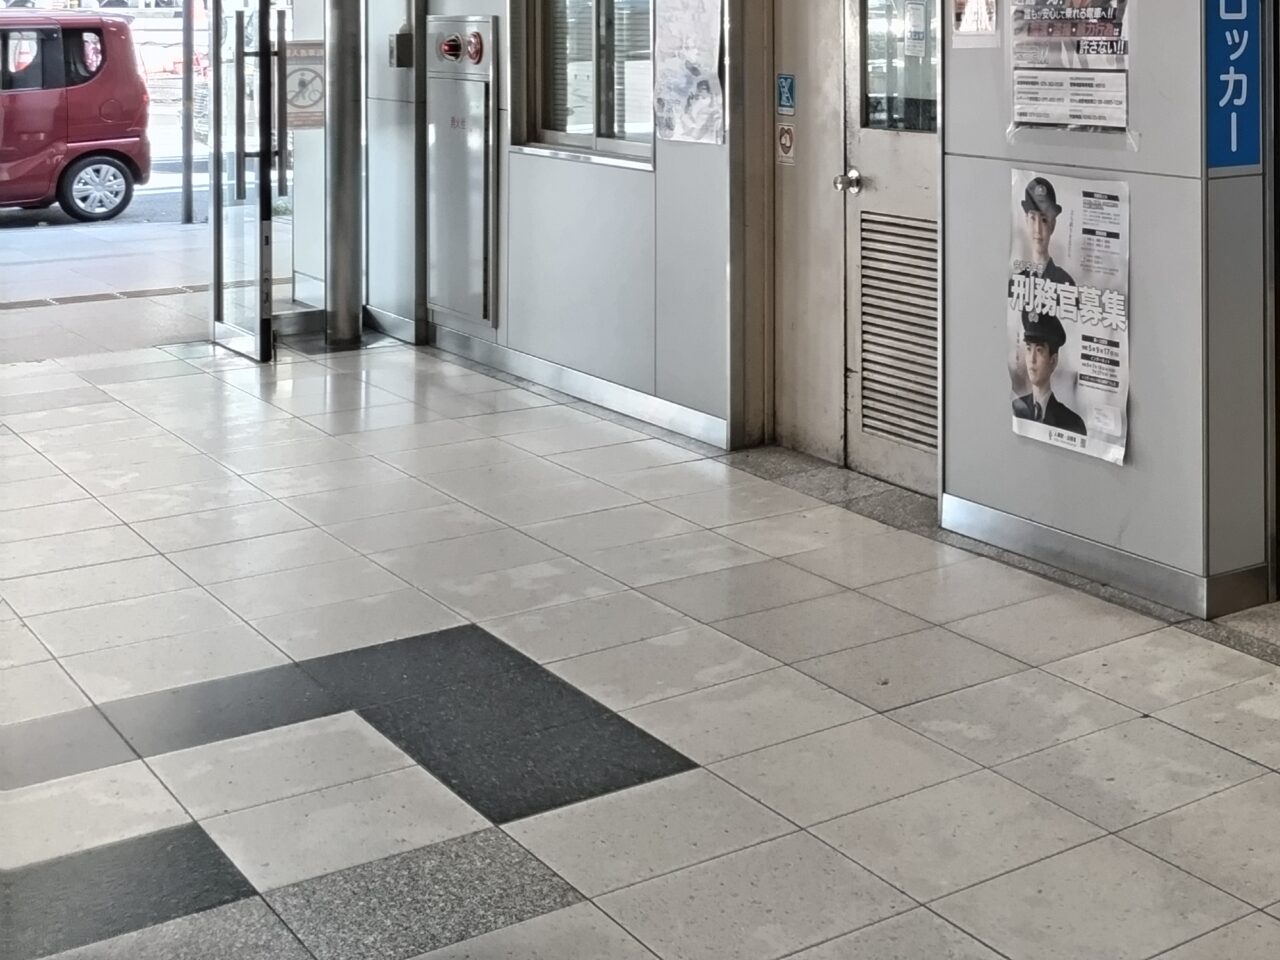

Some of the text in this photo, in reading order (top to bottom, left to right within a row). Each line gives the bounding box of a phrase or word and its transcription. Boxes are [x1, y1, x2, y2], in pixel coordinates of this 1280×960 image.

[1010, 273, 1127, 331] 刑務官募集
